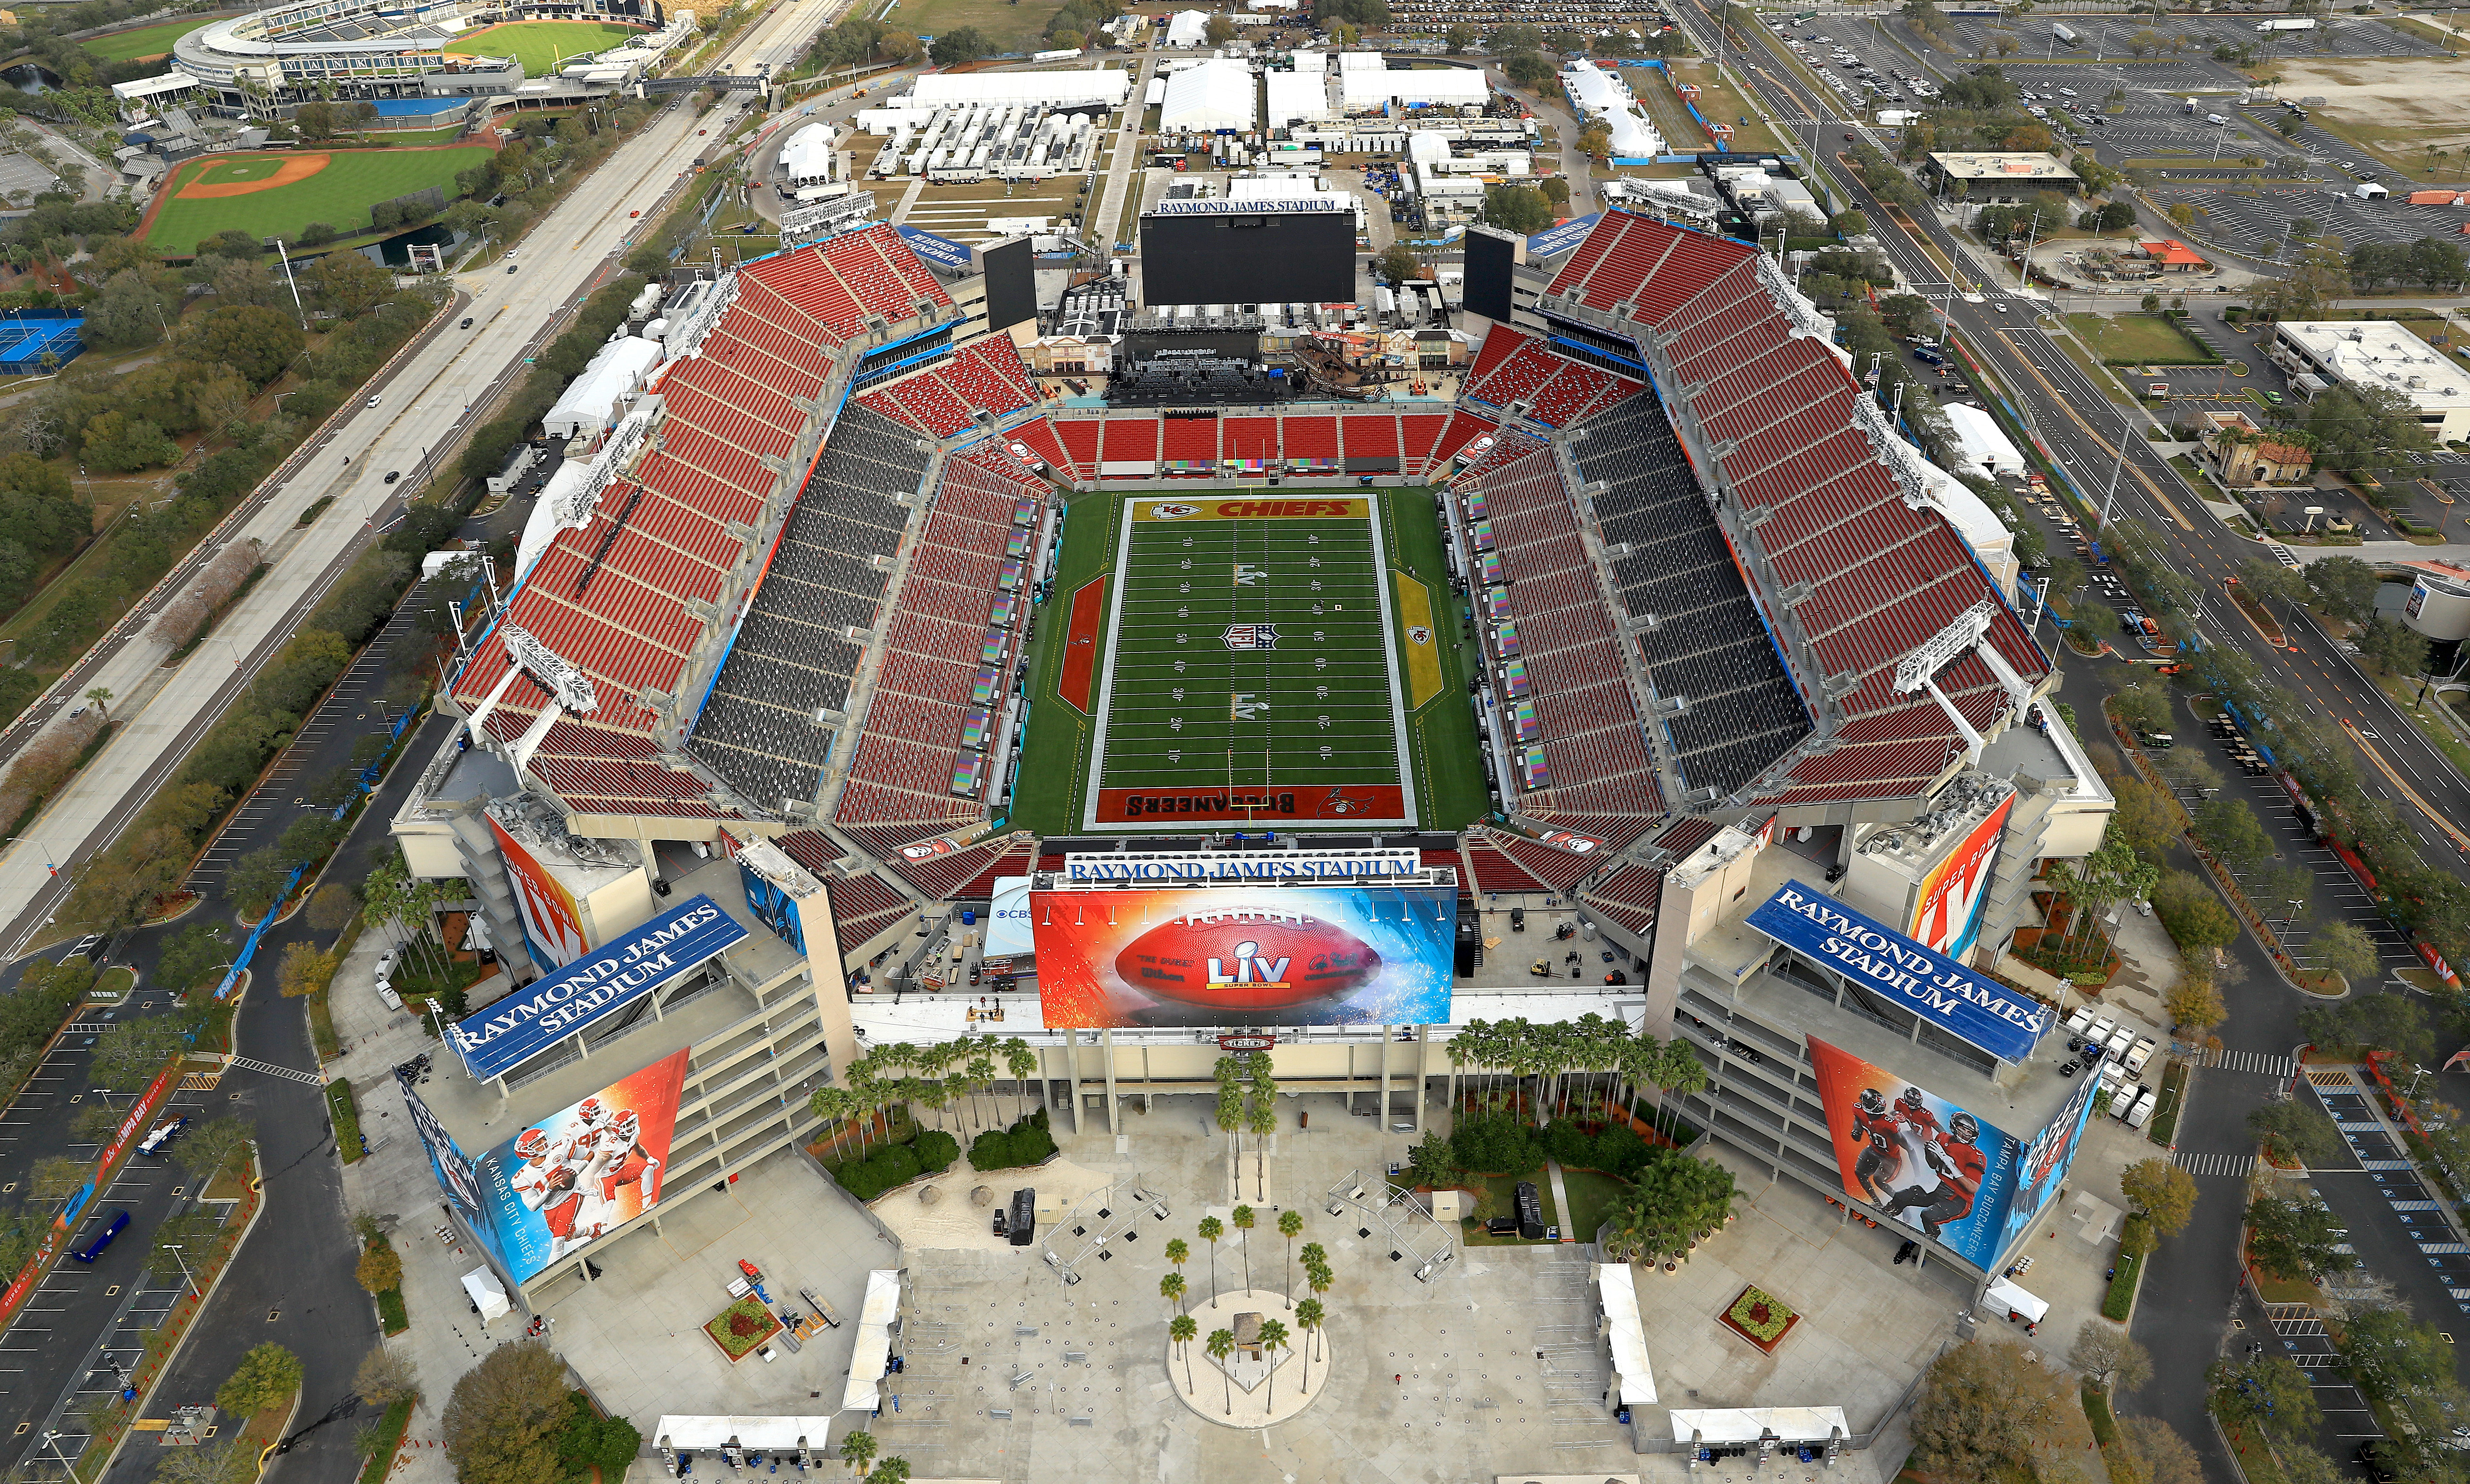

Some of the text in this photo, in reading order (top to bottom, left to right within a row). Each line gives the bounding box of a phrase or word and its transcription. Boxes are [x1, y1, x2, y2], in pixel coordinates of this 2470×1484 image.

[286, 57, 435, 70] YANKEES
[1160, 200, 1335, 213] RAYMOND JAMES STADIUM
[1537, 222, 1589, 242] STADIUM
[908, 234, 960, 252] STADIUM
[1530, 237, 1570, 254] JAMES
[909, 242, 969, 265] RAYMOND
[1543, 311, 1564, 321] ASSISTANCE?
[1617, 335, 1634, 343] LOCATION
[1217, 501, 1352, 517] CHIEFS
[1183, 538, 1193, 547] 10
[1308, 534, 1319, 544] 10
[1181, 560, 1192, 569] 20
[1309, 557, 1320, 567] 20
[1180, 584, 1190, 593] 30
[1311, 582, 1322, 591] 30
[1178, 608, 1189, 617] 40
[1312, 606, 1323, 616] 40
[1176, 633, 1187, 643] 50
[1314, 631, 1325, 642] 50
[1174, 660, 1186, 671] 40
[1315, 658, 1326, 669] 40
[1172, 688, 1184, 699] 30
[1316, 686, 1328, 697] 30
[1171, 717, 1182, 729] 20
[1318, 715, 1330, 727] 20
[1168, 749, 1180, 760] 10
[1320, 746, 1332, 757] 10
[1125, 790, 1295, 816] BUCCANEERS
[1069, 860, 1416, 880] RAYMOND JAMES STADIUM
[1924, 826, 2003, 912] SUPER BOWL
[500, 850, 579, 933] SUPER BOWL
[1775, 888, 2041, 1033] RAYMOND JAMES
[459, 902, 719, 1053] RAYMOND JAMES
[1140, 967, 1185, 982] Wilson
[1818, 936, 1962, 1017] STADIUM
[539, 951, 677, 1034] STADIUM
[1226, 1039, 1270, 1048] TICKETS
[115, 1115, 138, 1149] TAMPA
[132, 1100, 148, 1125] BAY
[146, 1085, 159, 1104] SUPER
[398, 1079, 450, 1148] CHIEFS
[412, 1108, 478, 1196] KINGDOM
[1966, 1136, 2016, 1259] TAMPA BAY BUCCANEERS
[486, 1157, 537, 1266] KANSAS CITY CHIEFS
[4, 1283, 21, 1307] SUPER
